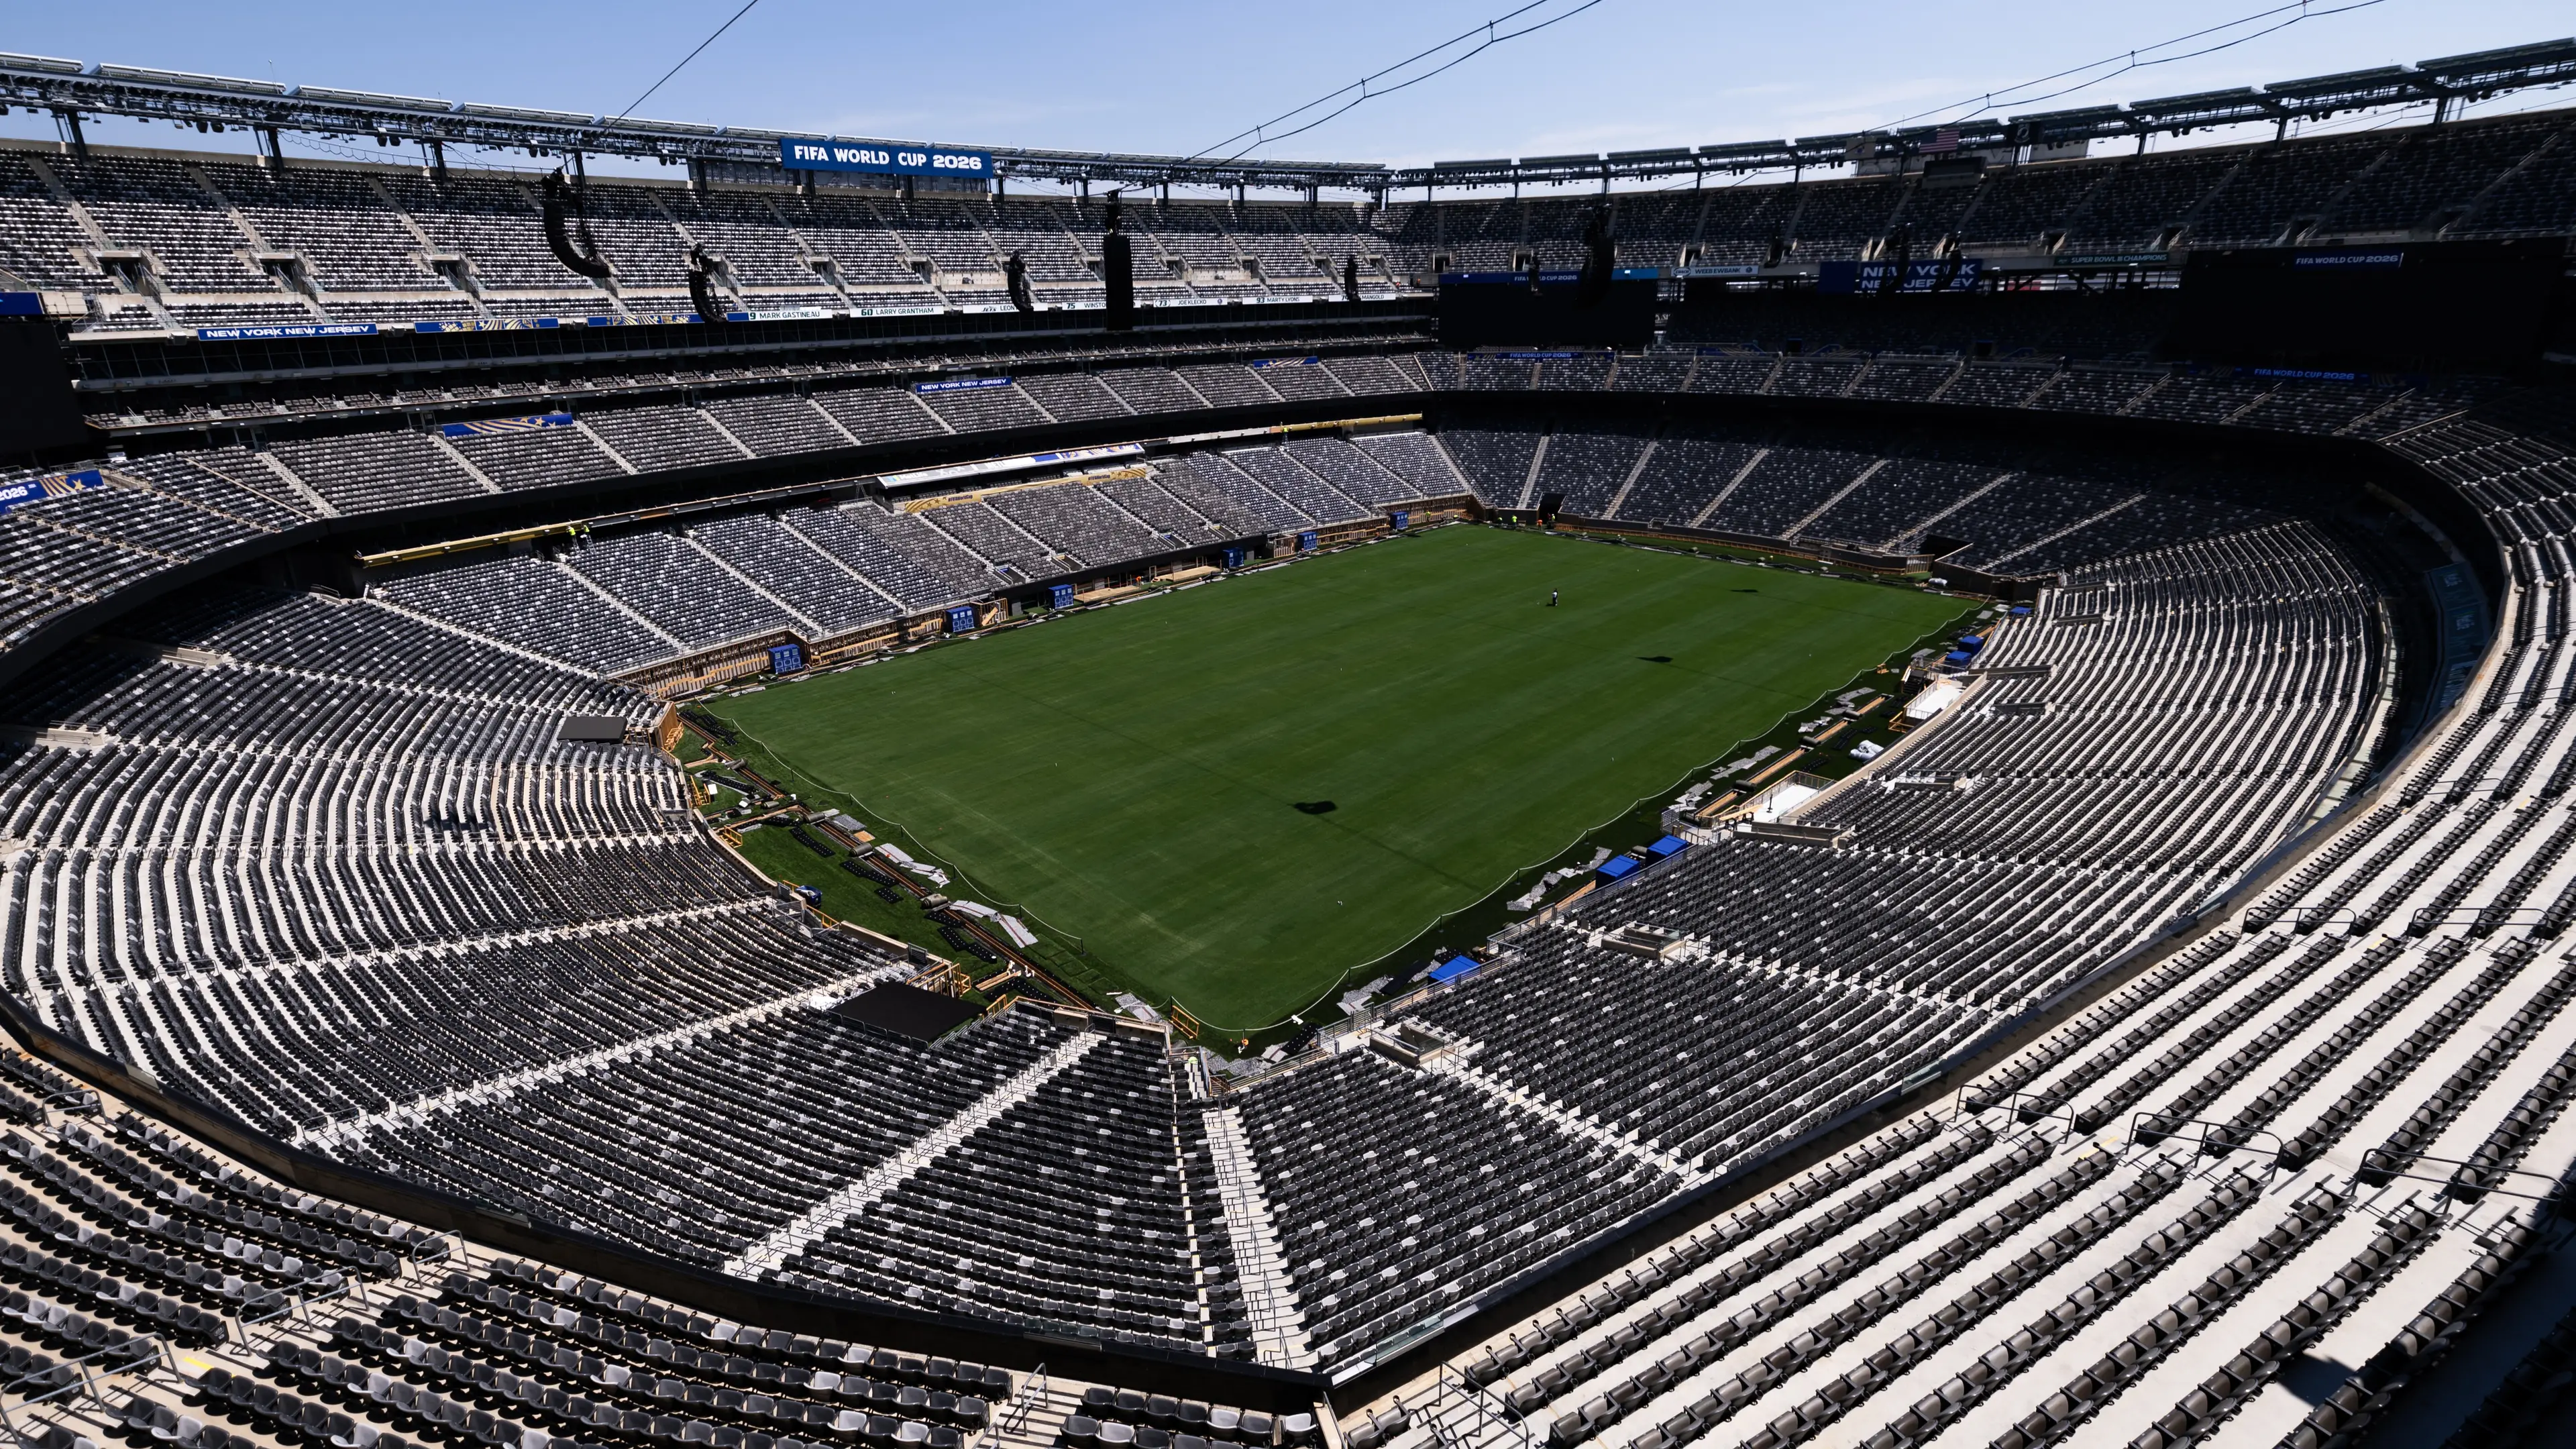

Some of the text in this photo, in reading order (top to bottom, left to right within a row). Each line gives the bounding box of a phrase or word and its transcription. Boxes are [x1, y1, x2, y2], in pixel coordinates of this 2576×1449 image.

[794, 145, 982, 170] FIFA WORLD CUP 2026
[1903, 278, 1974, 288] JEREY
[243, 329, 282, 337] YORK
[2273, 369, 2303, 377] WORLD
[2322, 372, 2355, 380] 2026
